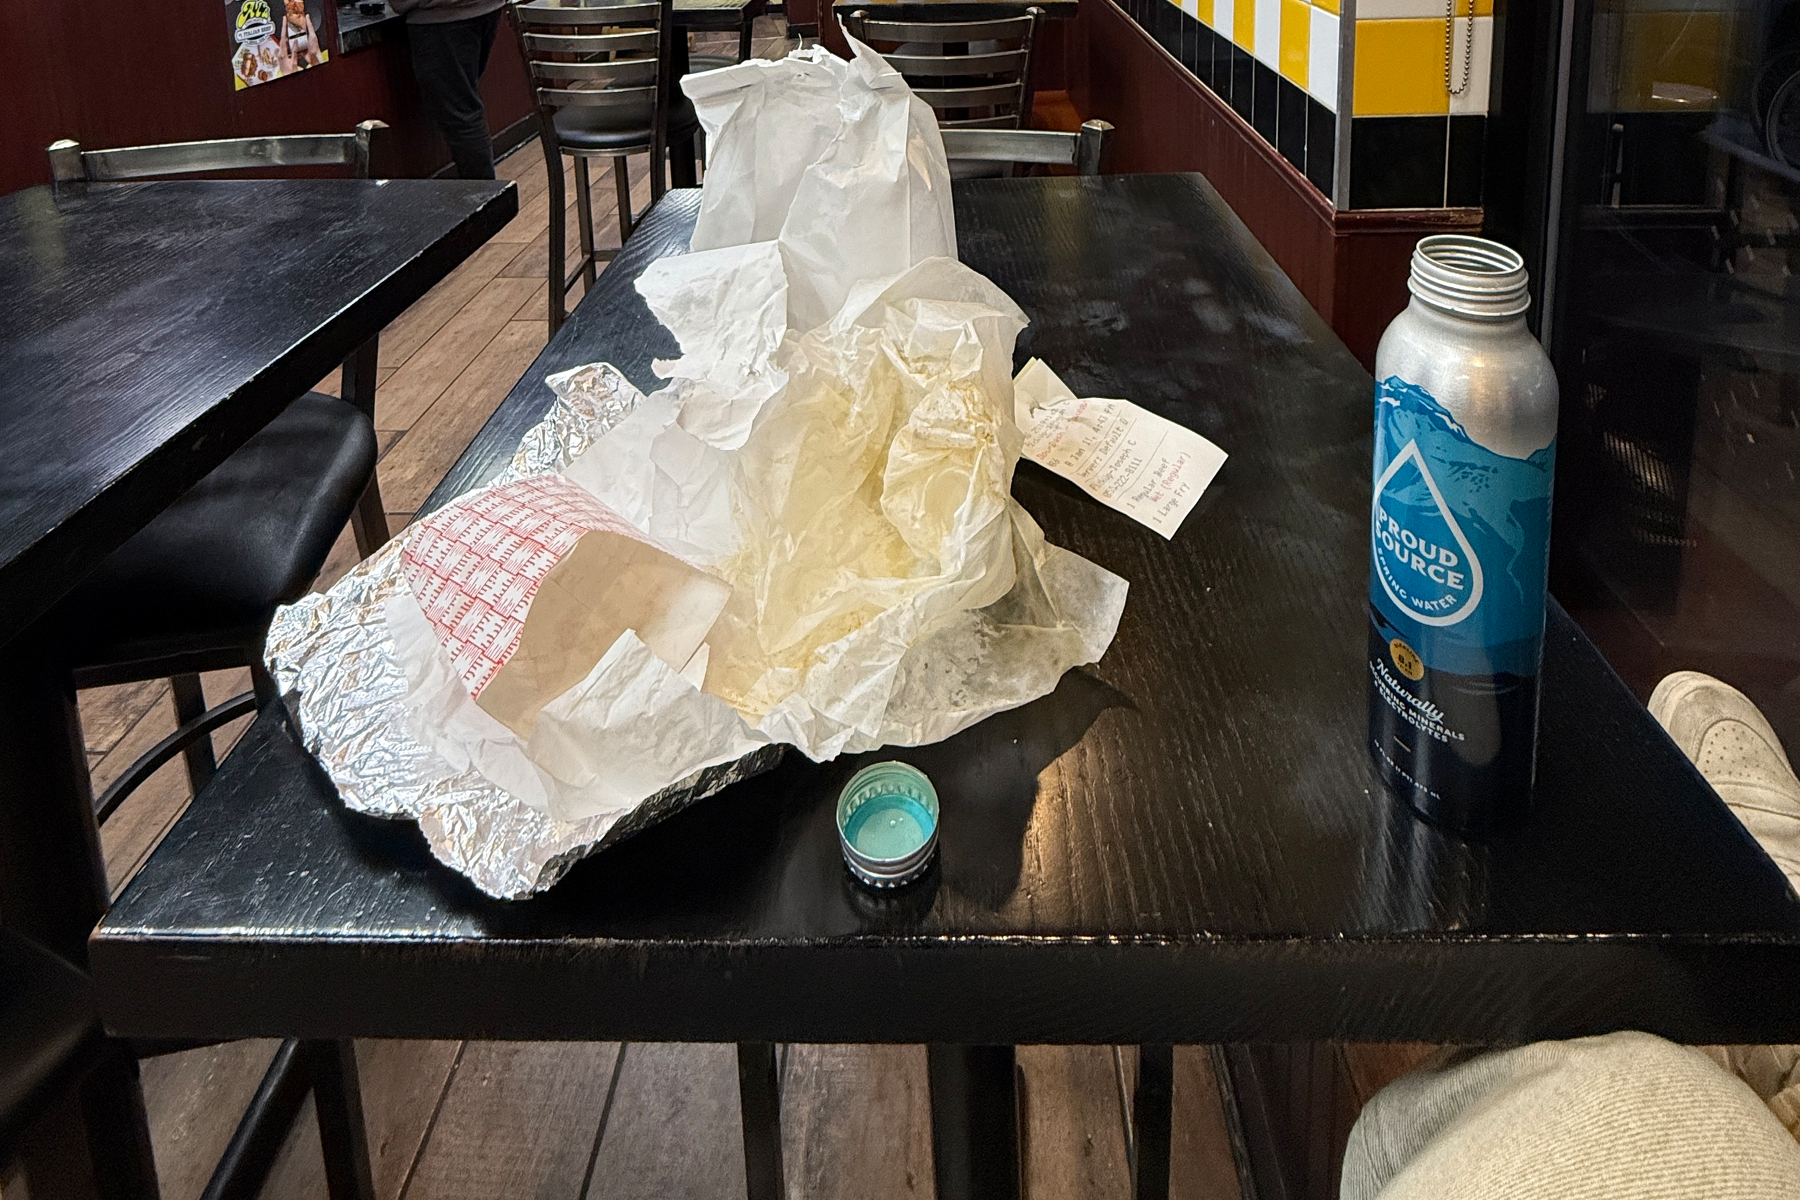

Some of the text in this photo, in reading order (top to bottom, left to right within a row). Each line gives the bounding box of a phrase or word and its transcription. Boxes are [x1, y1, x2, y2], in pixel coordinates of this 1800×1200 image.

[243, 29, 260, 38] ITALIAN
[1070, 447, 1085, 461] Jan
[1104, 403, 1116, 415] PM
[1077, 456, 1103, 478] erver:
[1099, 426, 1124, 456] Default
[1131, 479, 1157, 503] Regular
[1153, 457, 1170, 478] Beef
[1148, 451, 1191, 503] Wet (Regular)
[1157, 497, 1179, 517] Large
[1173, 481, 1191, 498] Fry
[1376, 521, 1464, 590] SOURCE
[1380, 505, 1458, 567] PROUD
[1377, 547, 1457, 611] SPRING WATER
[1376, 658, 1444, 725] Naturally
[1379, 686, 1448, 743] ELECTROLYTES
[1408, 708, 1465, 741] MINERALS
